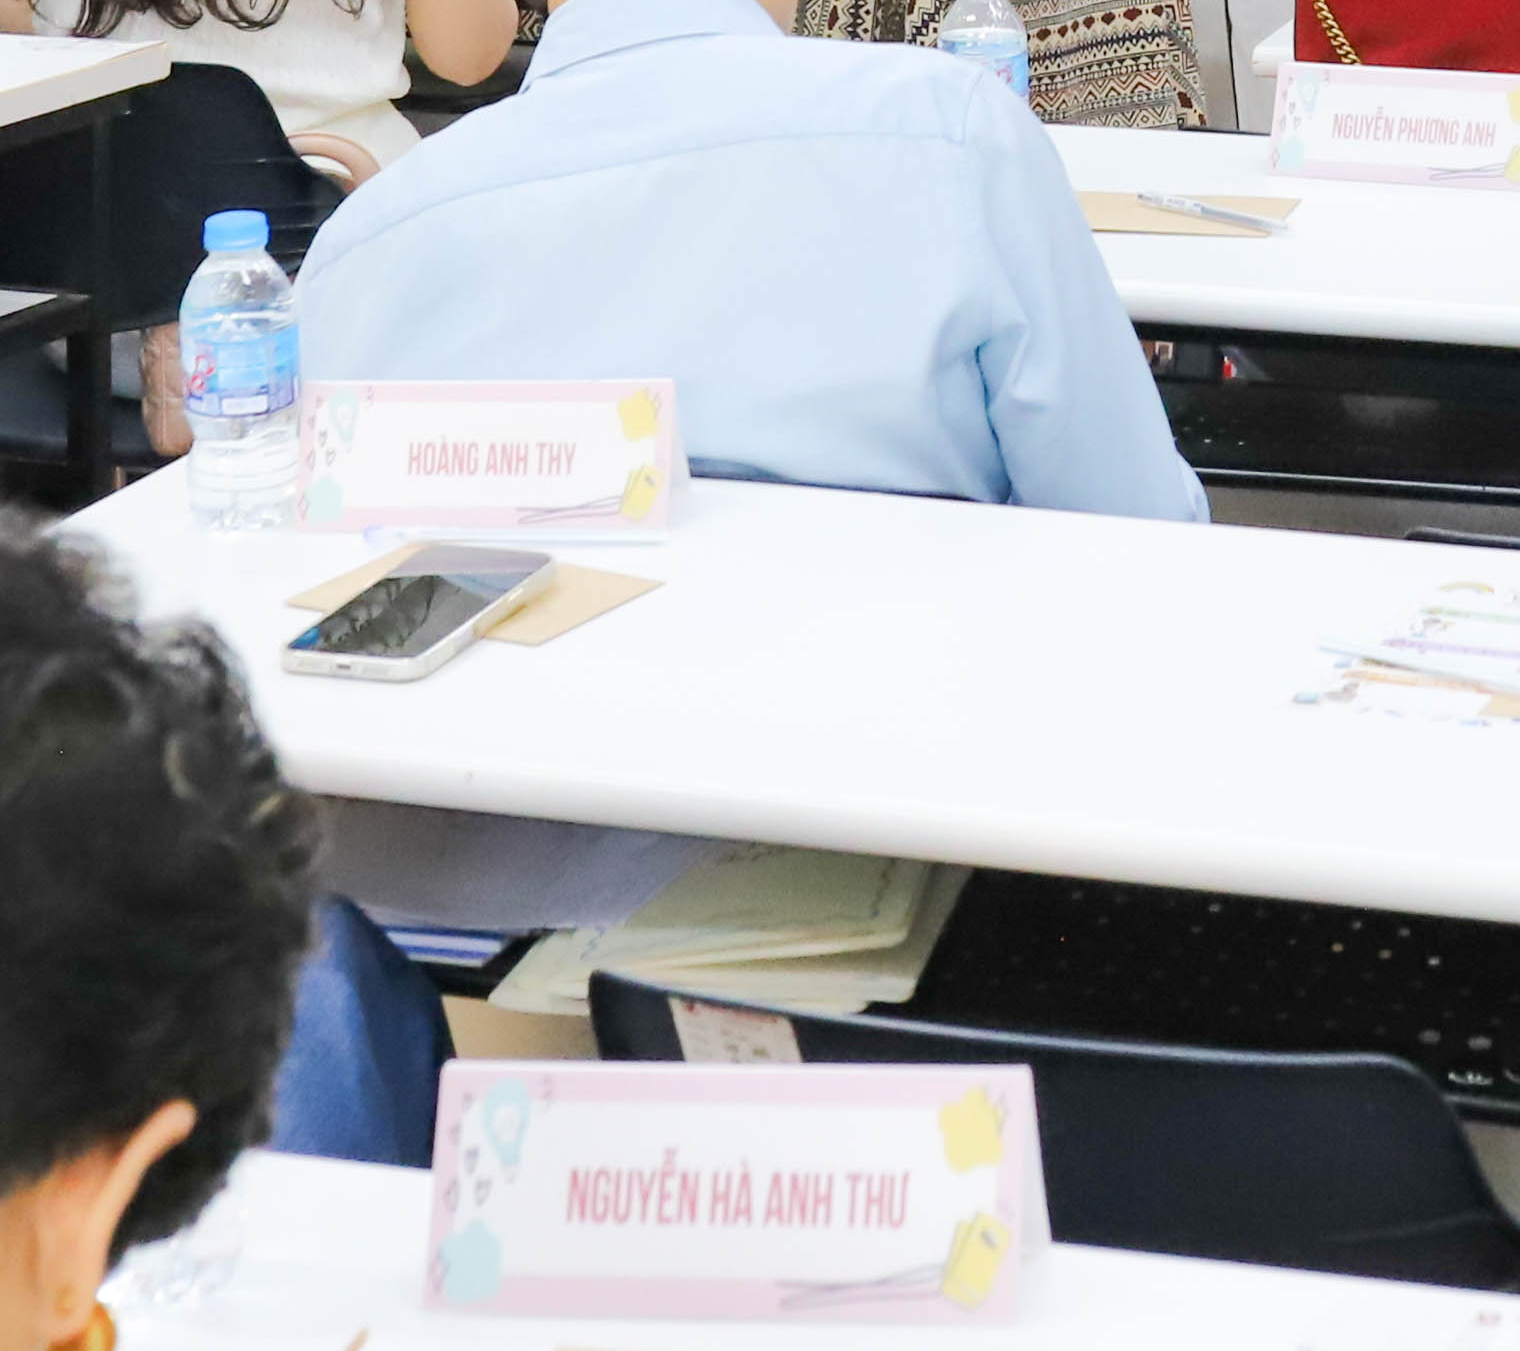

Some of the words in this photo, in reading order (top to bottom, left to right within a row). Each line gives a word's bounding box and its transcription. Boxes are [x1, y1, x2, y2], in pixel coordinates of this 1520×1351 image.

[1332, 106, 1394, 141] NGUYỄN
[1397, 115, 1460, 145] PHƯƠNG
[1462, 121, 1497, 147] ANH
[407, 434, 480, 476] HOÀNG
[484, 441, 529, 476] ANH
[535, 441, 577, 475] THY
[566, 1148, 701, 1225] NGUYỄN
[709, 1157, 753, 1227] HÀ
[764, 1170, 834, 1228] ANH
[847, 1169, 910, 1230] THƯ
